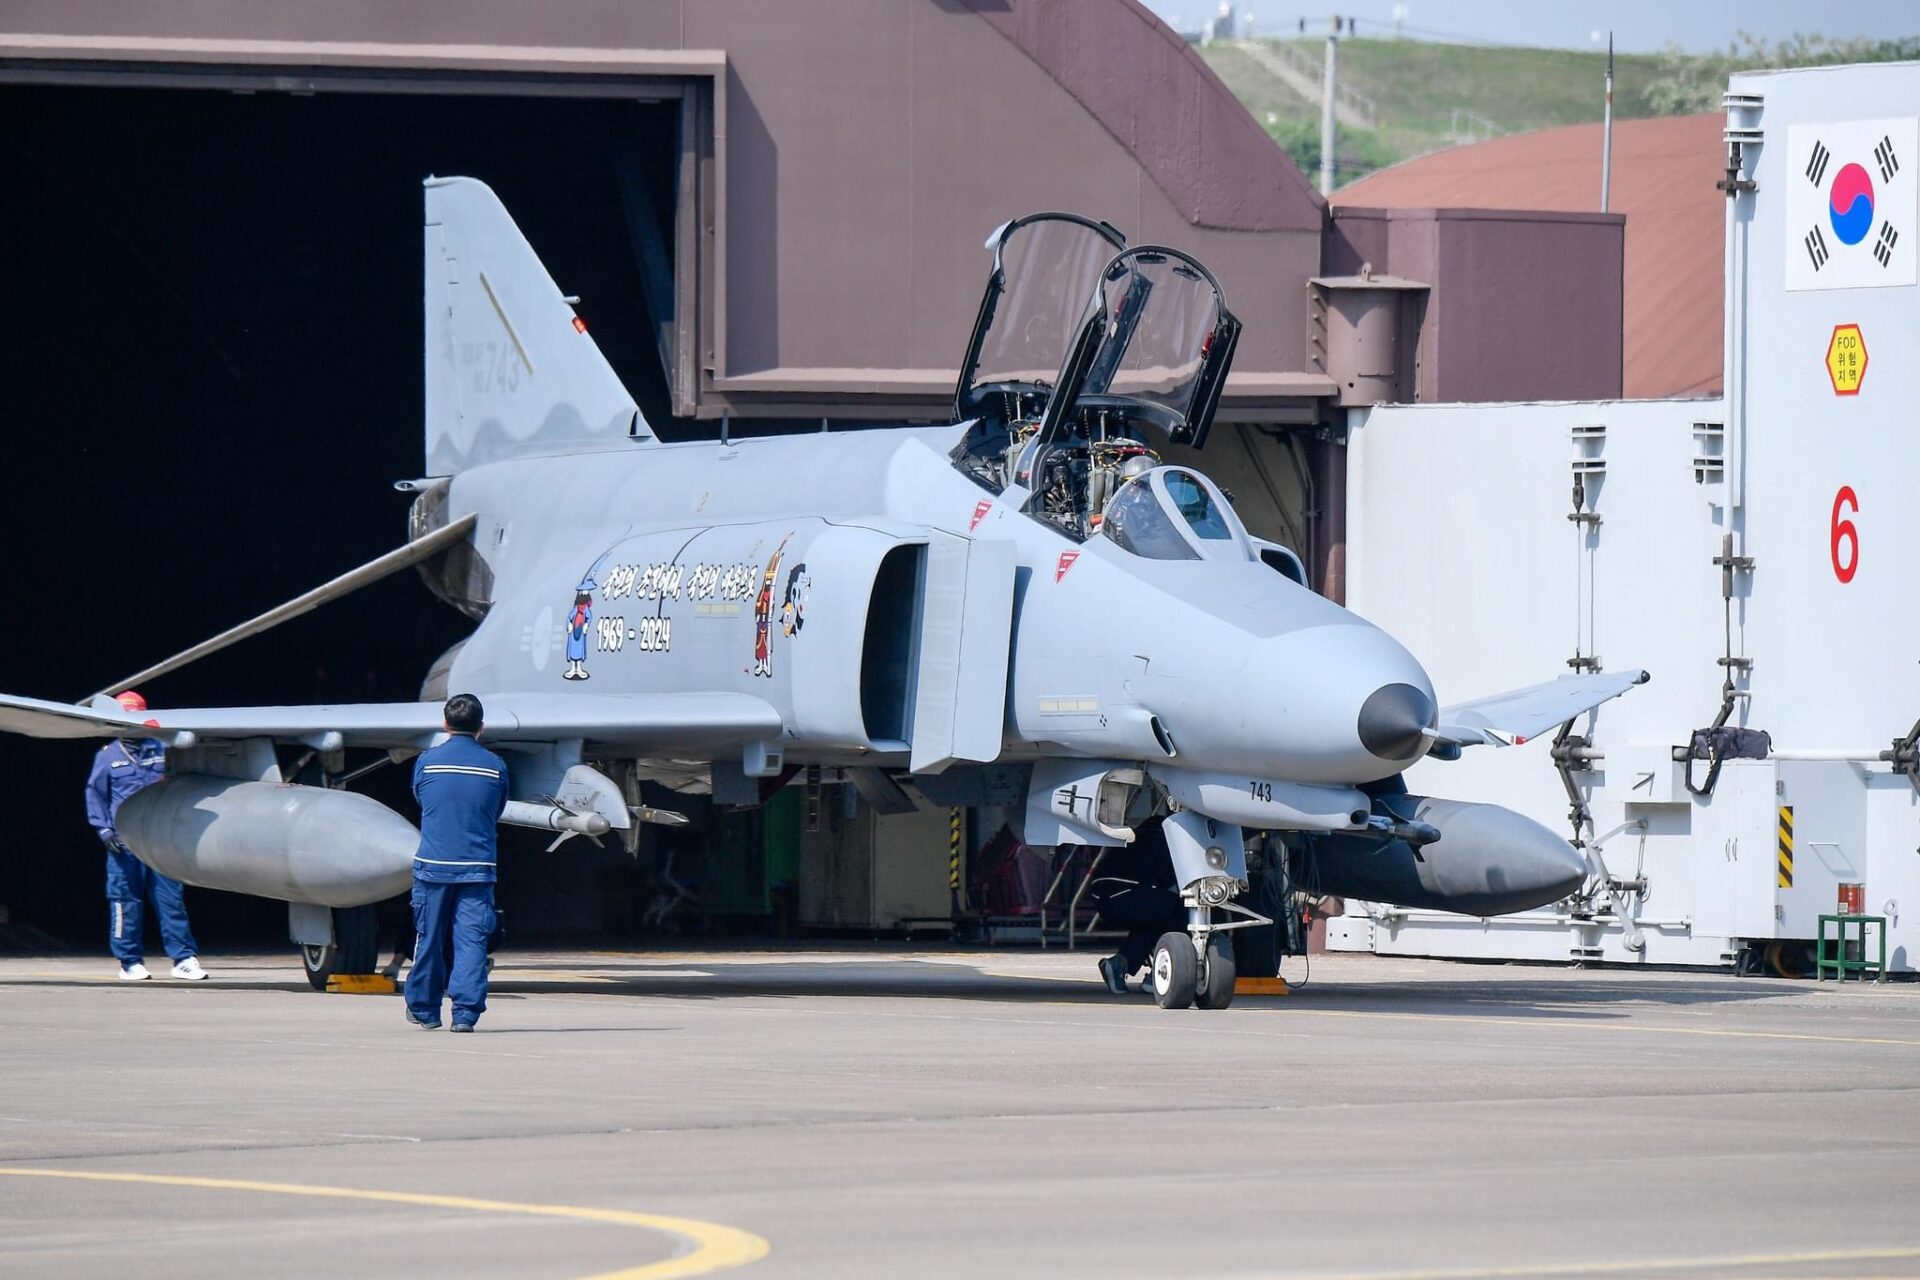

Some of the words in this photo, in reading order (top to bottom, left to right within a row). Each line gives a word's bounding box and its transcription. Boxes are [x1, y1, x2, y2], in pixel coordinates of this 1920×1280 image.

[1837, 336, 1856, 349] FOD
[485, 341, 519, 394] 743
[1837, 352, 1856, 366] 위험
[1838, 369, 1856, 383] 지역
[1831, 485, 1859, 584] 6
[602, 564, 640, 600] 국민의
[687, 563, 722, 601] 국민의
[597, 616, 624, 651] 1969
[640, 616, 671, 652] 2024
[1250, 781, 1272, 803] 743
